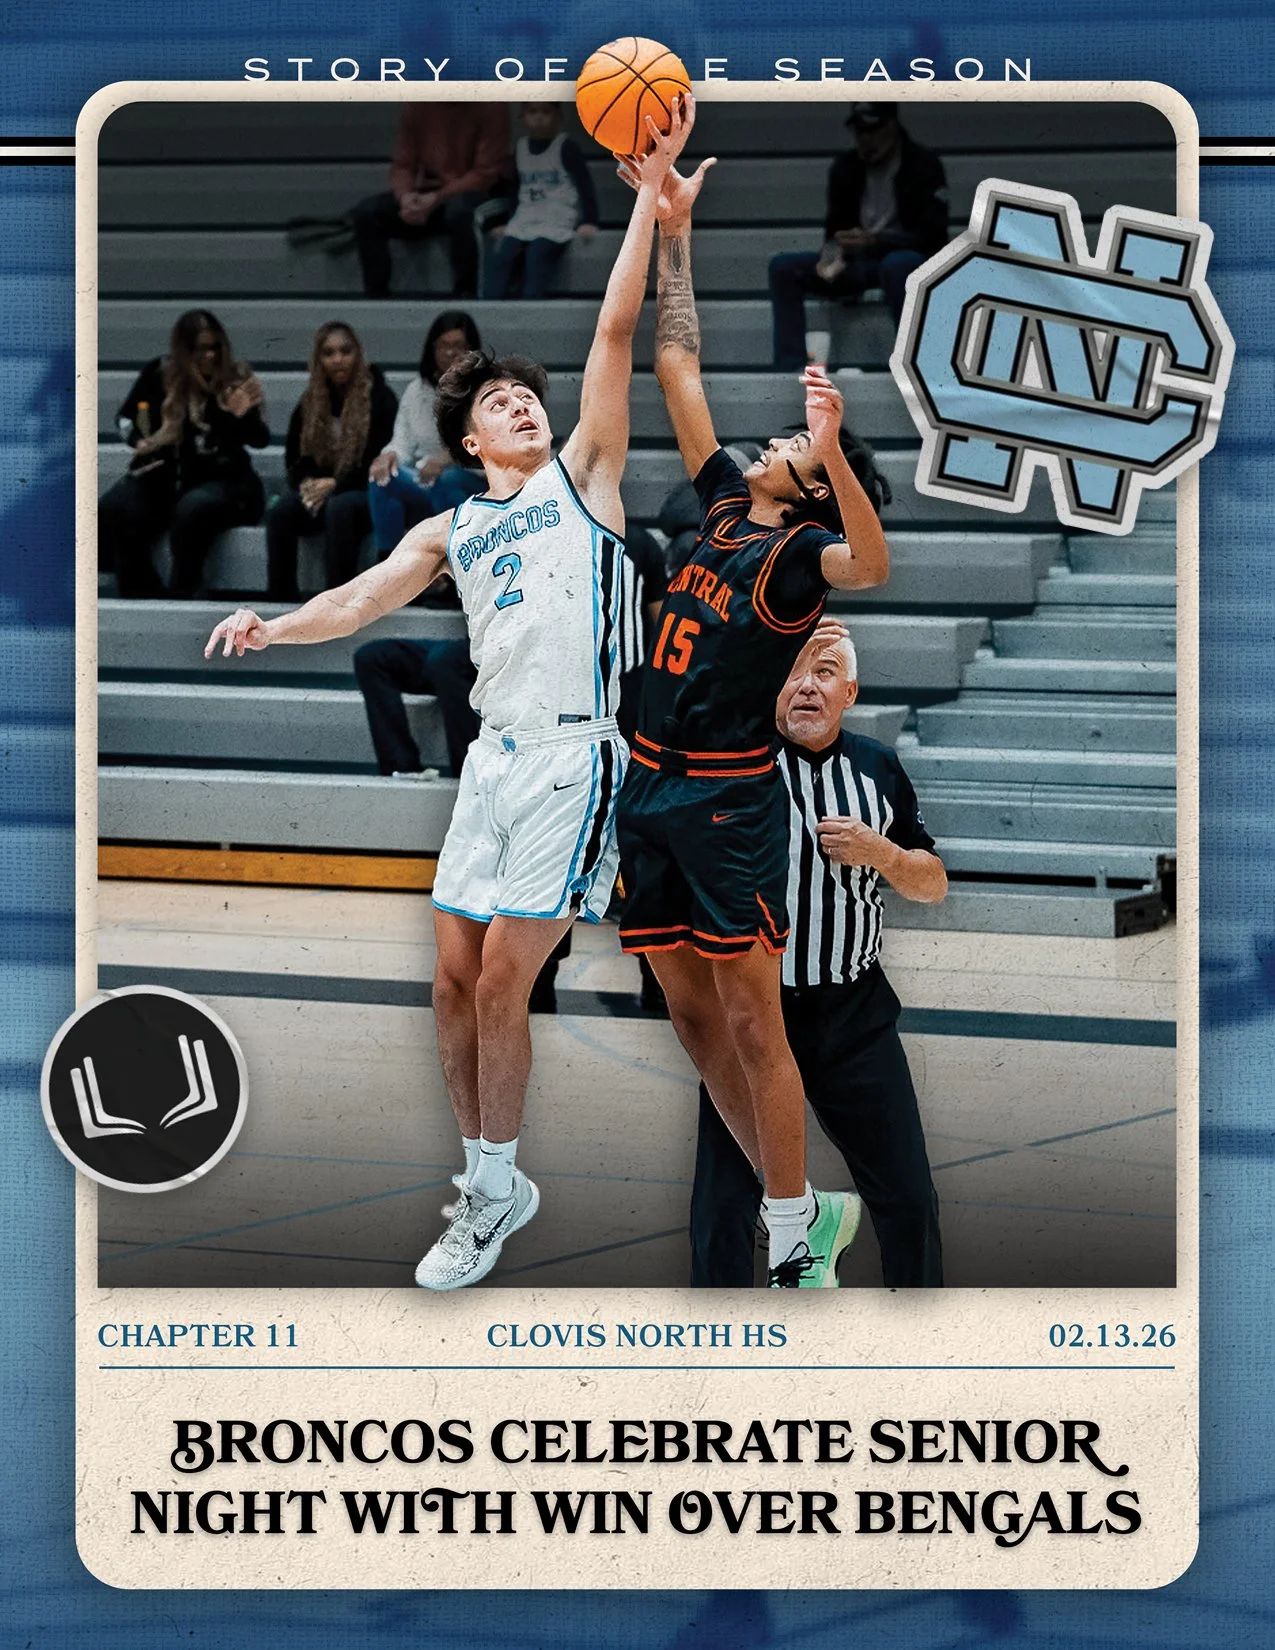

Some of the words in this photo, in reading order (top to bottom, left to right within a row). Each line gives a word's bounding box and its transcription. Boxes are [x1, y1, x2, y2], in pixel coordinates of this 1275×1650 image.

[456, 500, 561, 573] BRONCOS
[492, 552, 524, 611] 2
[667, 563, 733, 623] ENTRAL
[653, 612, 701, 676] 15
